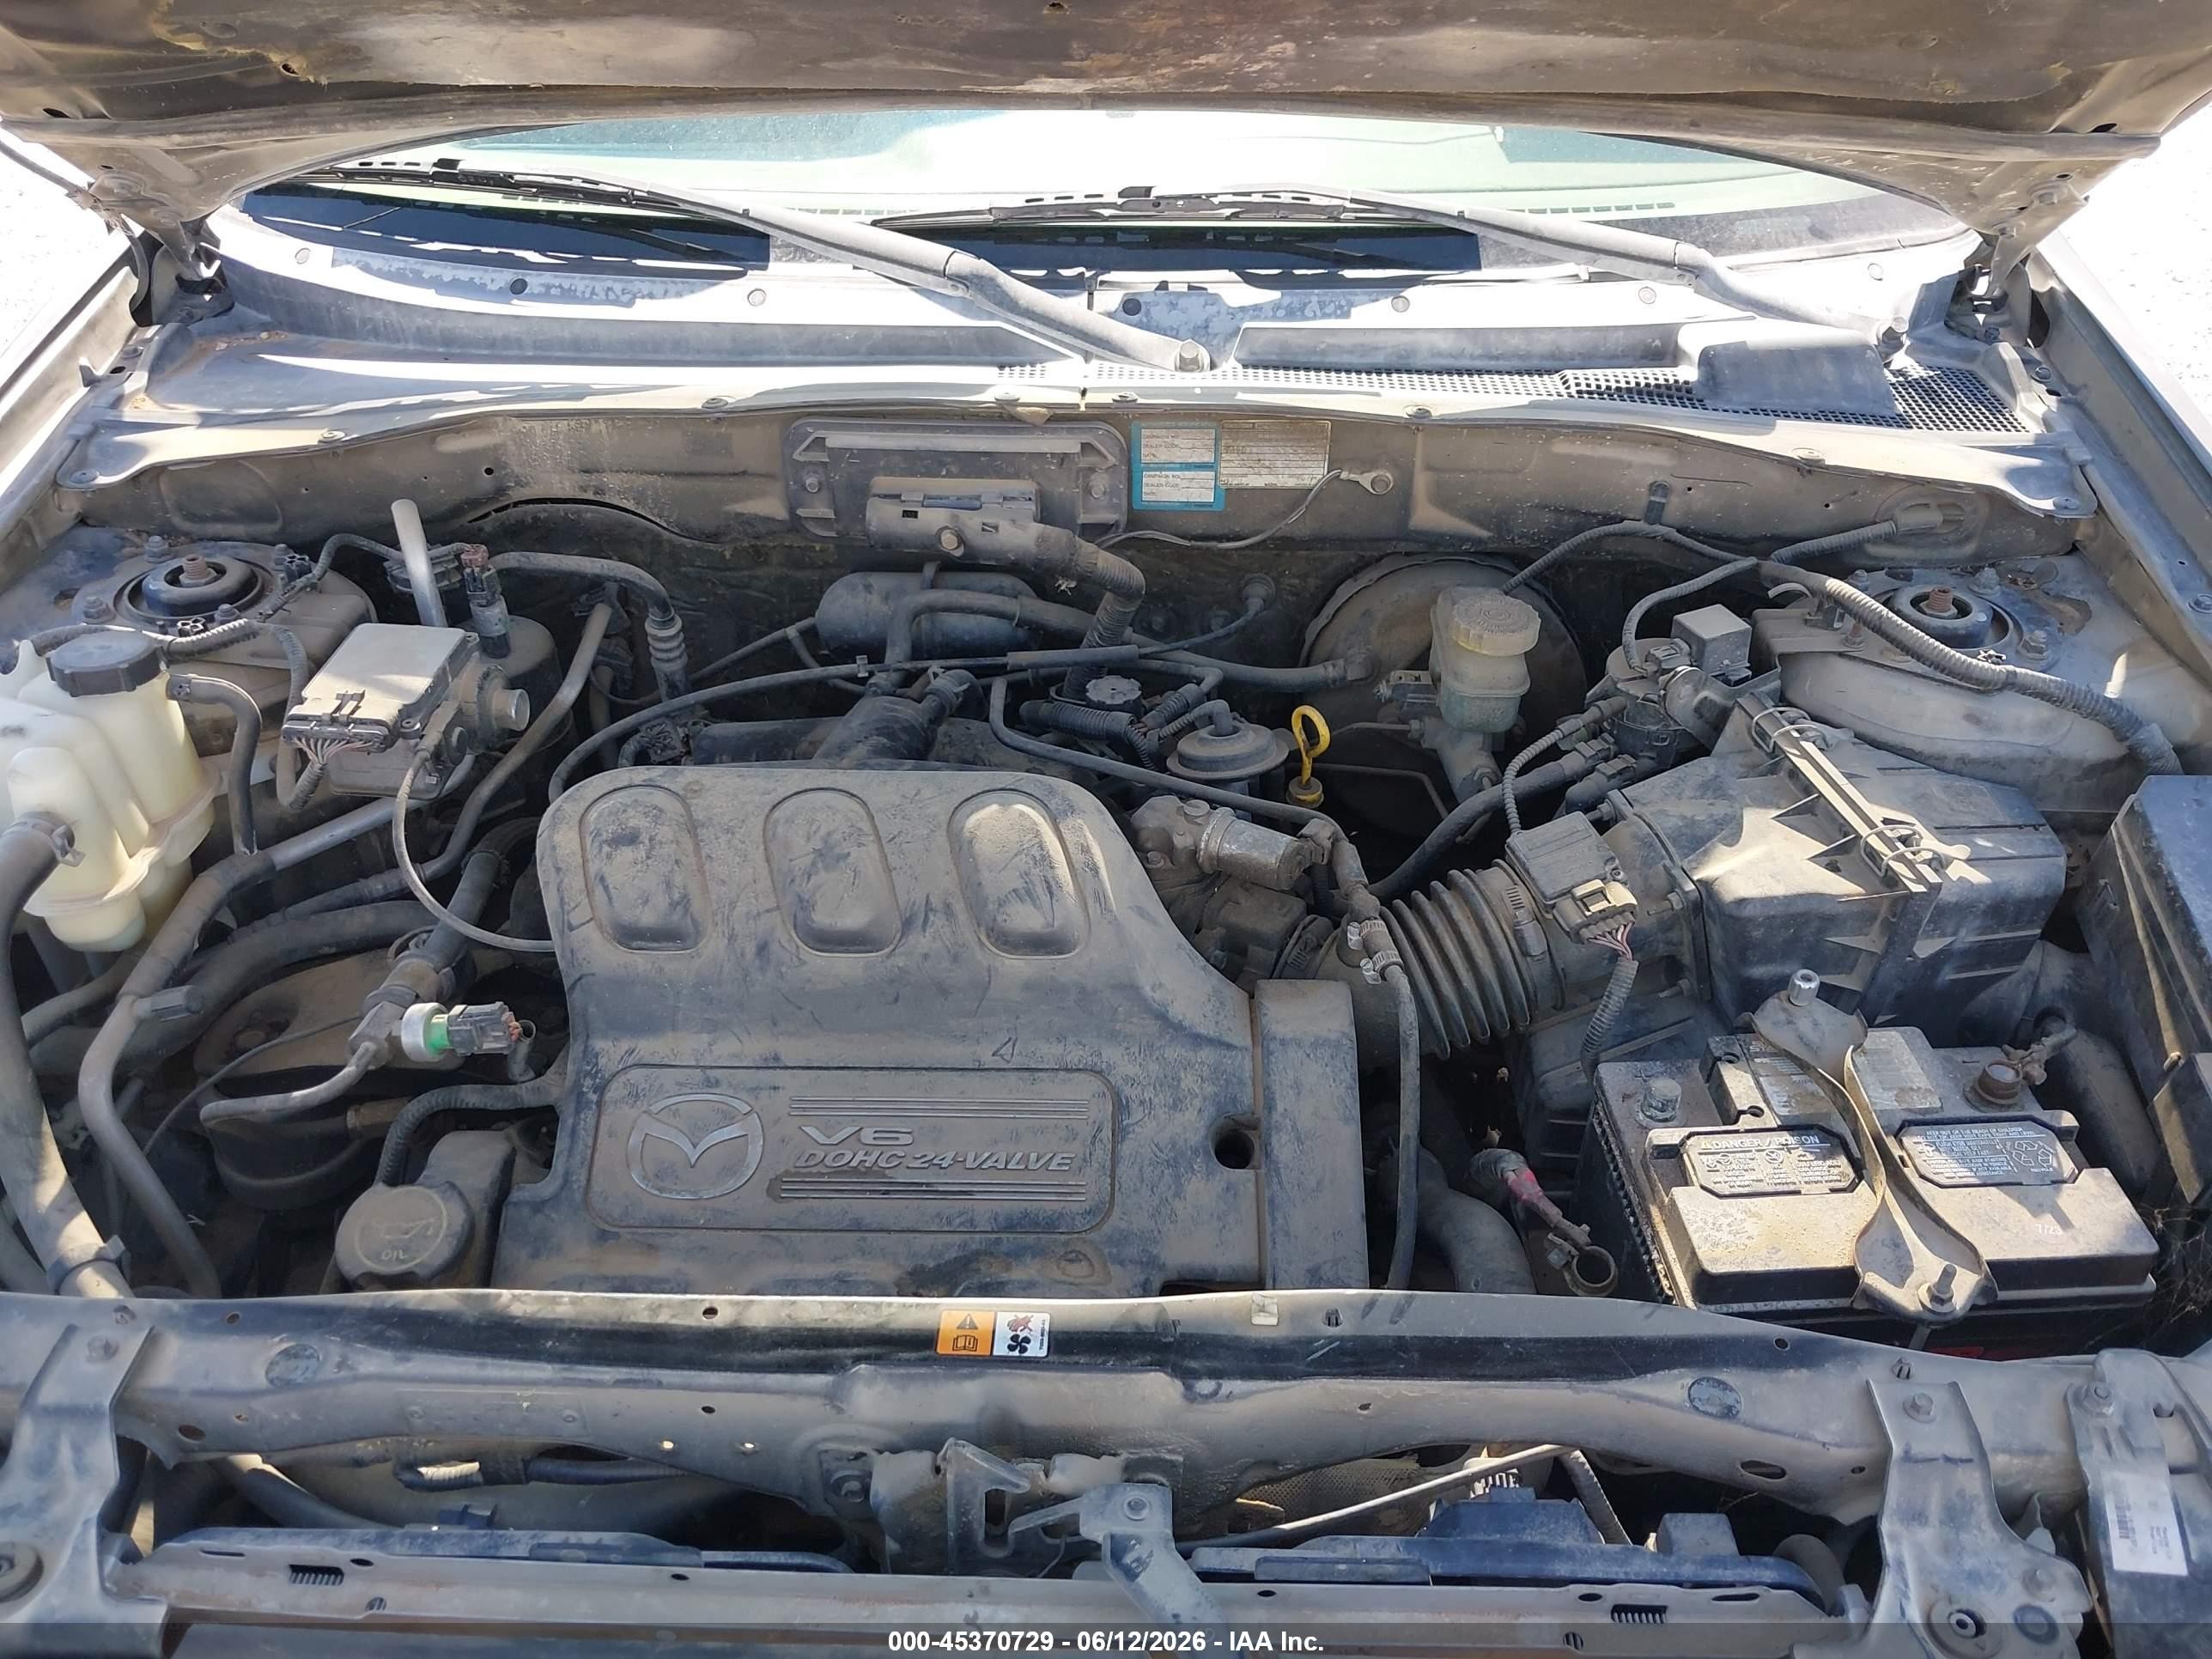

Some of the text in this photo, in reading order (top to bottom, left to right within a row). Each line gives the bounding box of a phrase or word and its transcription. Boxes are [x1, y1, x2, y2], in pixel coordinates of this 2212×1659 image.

[799, 1126, 914, 1146] V6
[1713, 1135, 1820, 1149] DANGER / POISON
[794, 1149, 1078, 1171] DOHC 24-VALVE
[380, 1249, 409, 1261] OIL
